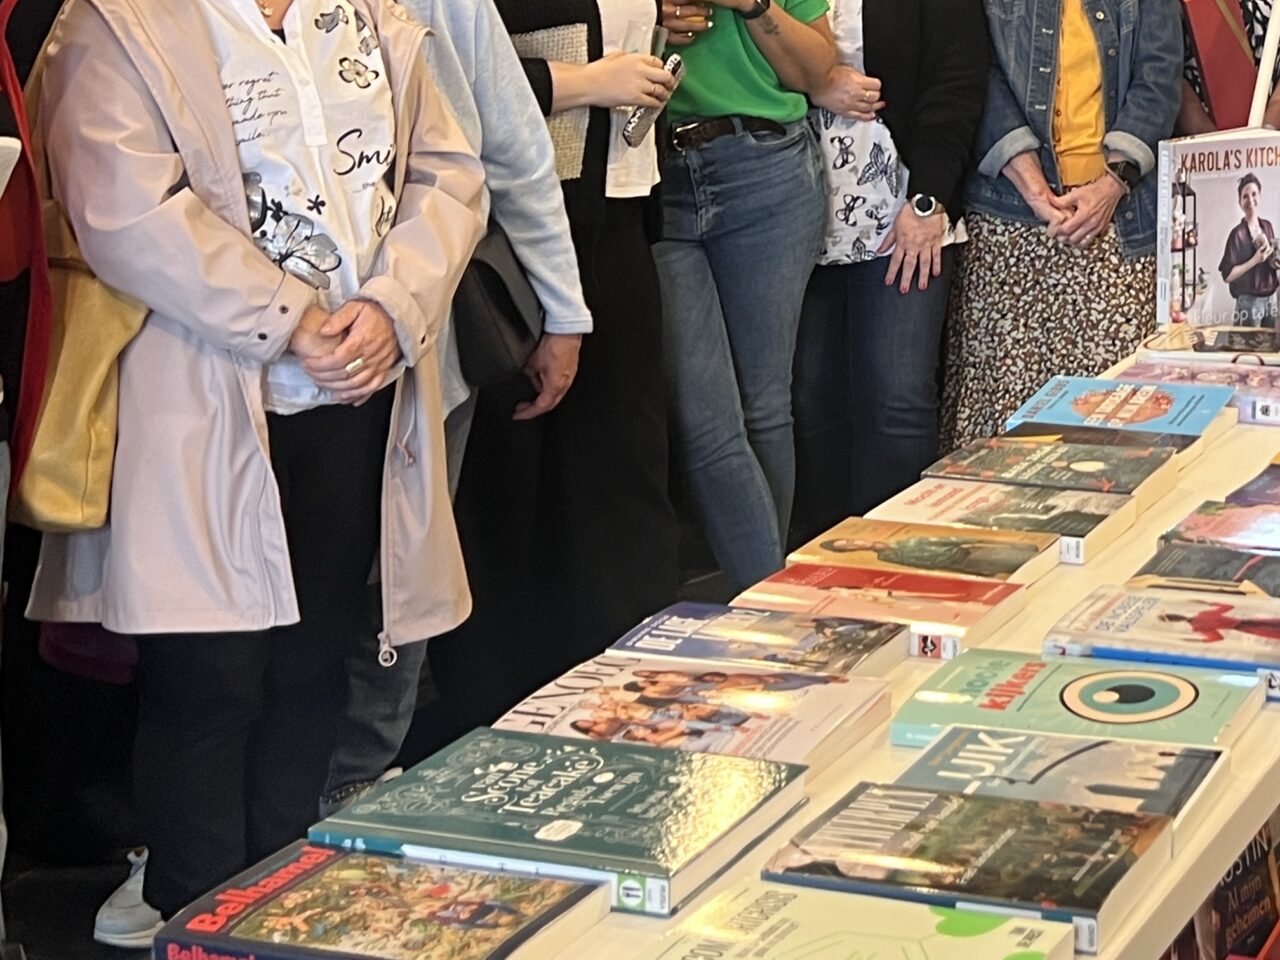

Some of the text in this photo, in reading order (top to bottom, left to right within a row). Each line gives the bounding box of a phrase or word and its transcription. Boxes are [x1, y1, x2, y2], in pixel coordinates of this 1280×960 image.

[239, 72, 280, 95] regret
[257, 88, 285, 100] that
[1179, 147, 1243, 174] KAROLA'S
[1230, 308, 1250, 325] op
[977, 662, 1048, 711] kijkers
[460, 760, 546, 806] Scone
[936, 730, 1029, 795] UIK
[497, 760, 595, 816] Teacake
[185, 844, 337, 934] Belhamel
[1225, 895, 1272, 949] geheimen
